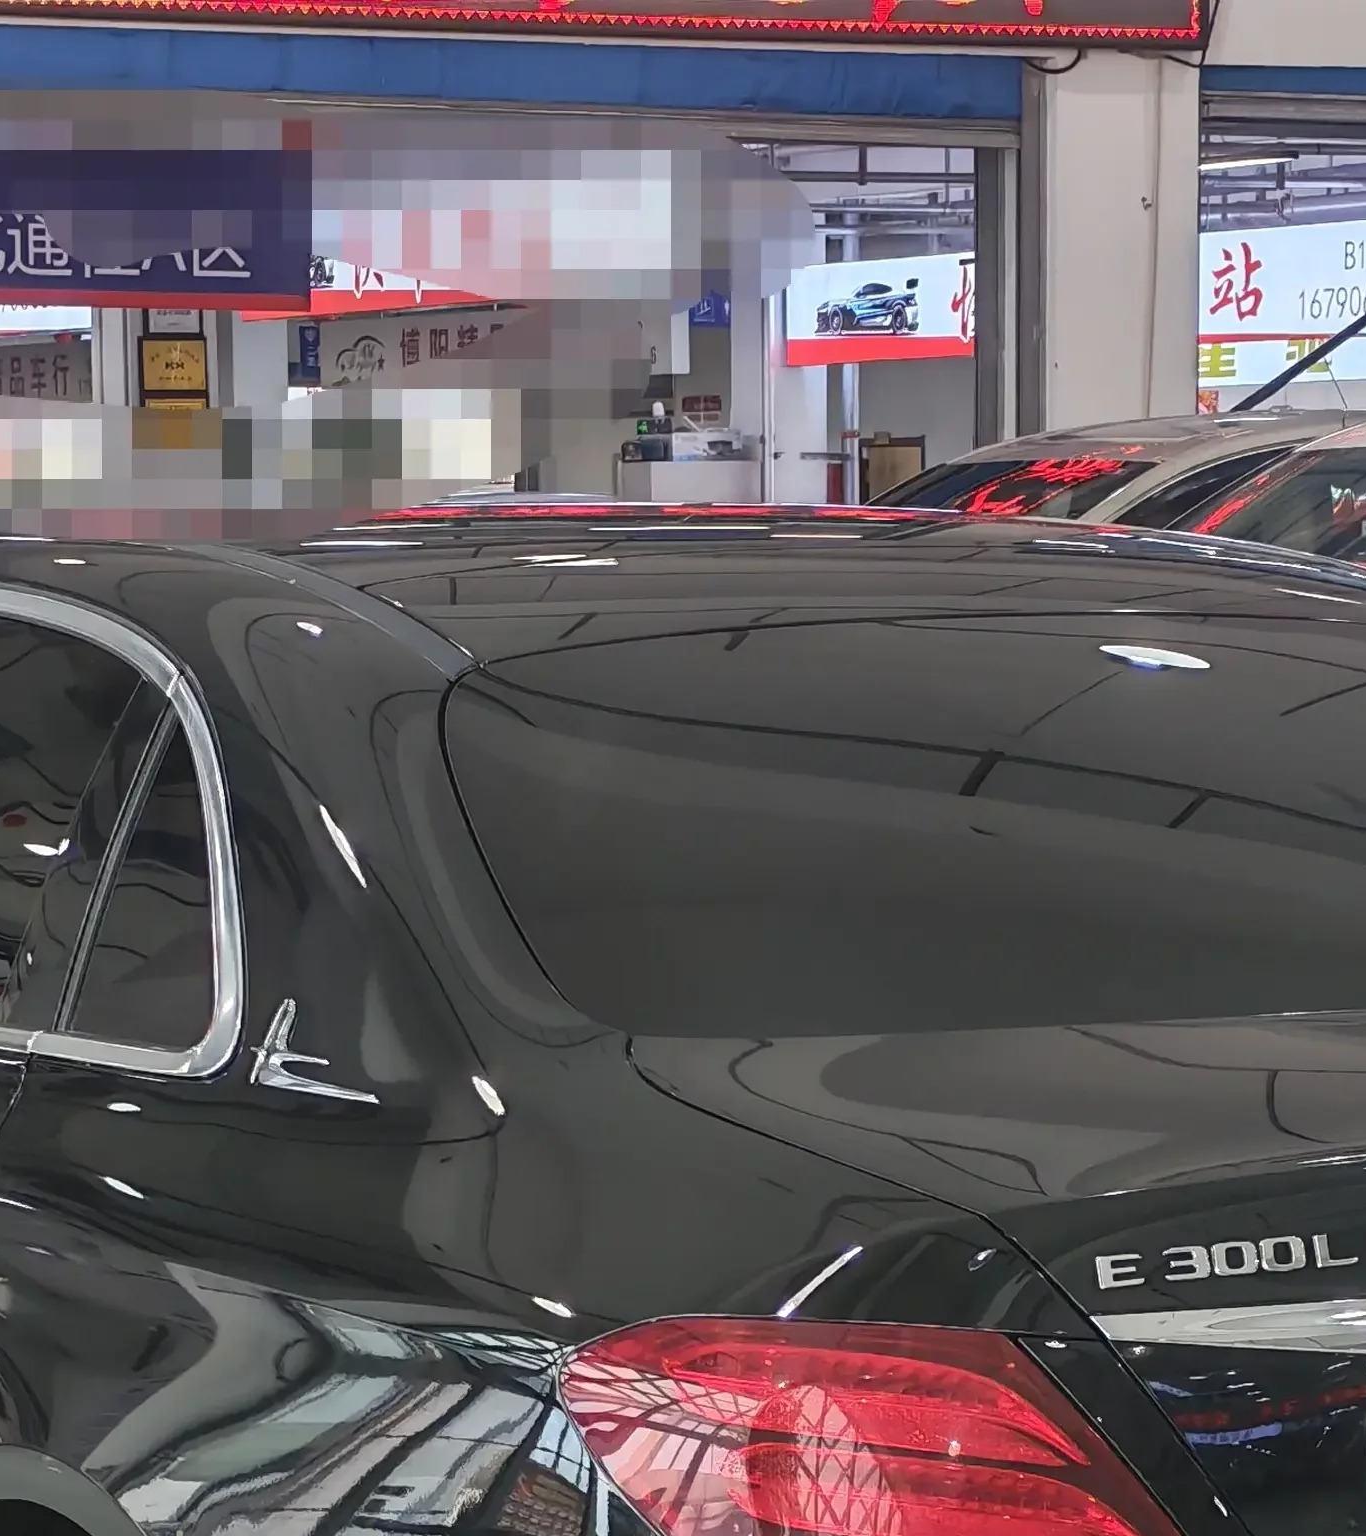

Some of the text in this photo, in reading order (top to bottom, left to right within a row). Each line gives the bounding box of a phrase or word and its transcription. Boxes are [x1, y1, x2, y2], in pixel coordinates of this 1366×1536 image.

[1210, 242, 1262, 321] 站
[1095, 1233, 1358, 1289] E 300L
